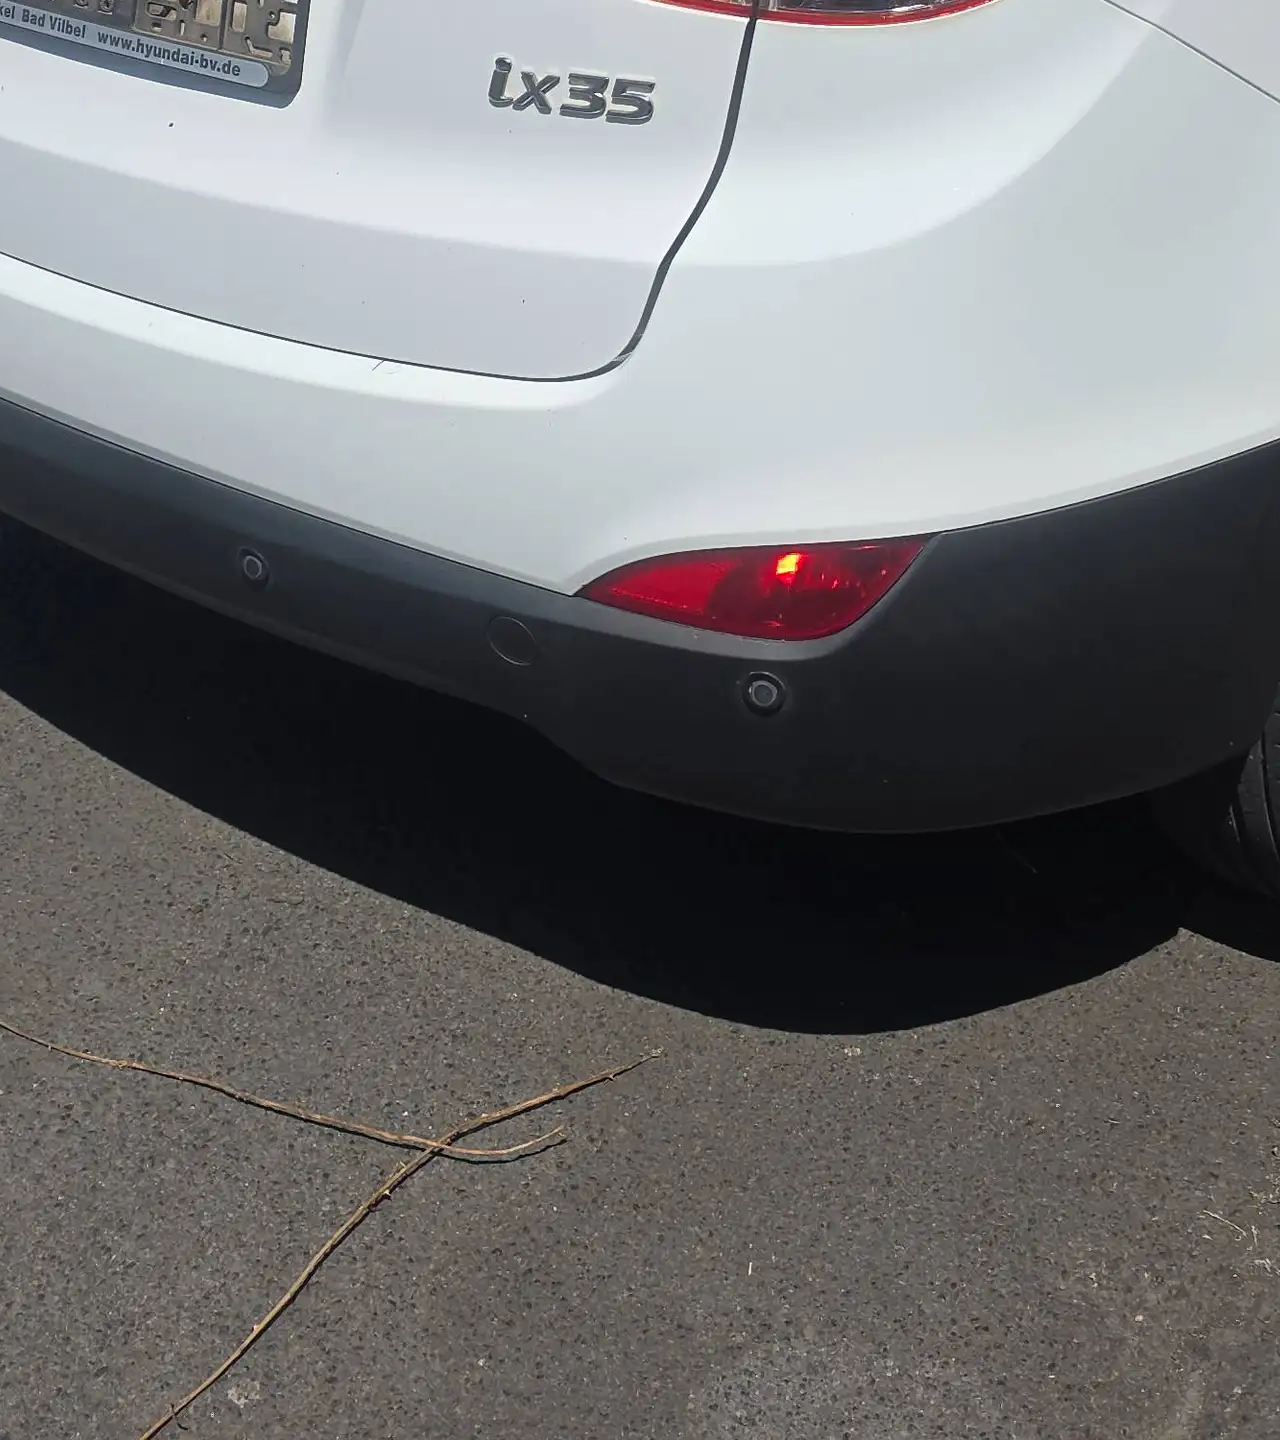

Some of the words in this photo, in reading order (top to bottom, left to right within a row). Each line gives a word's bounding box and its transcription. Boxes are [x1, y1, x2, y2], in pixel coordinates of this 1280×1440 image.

[21, 8, 46, 28] Bad
[49, 14, 86, 40] Vilbel
[488, 57, 656, 125] ix35
